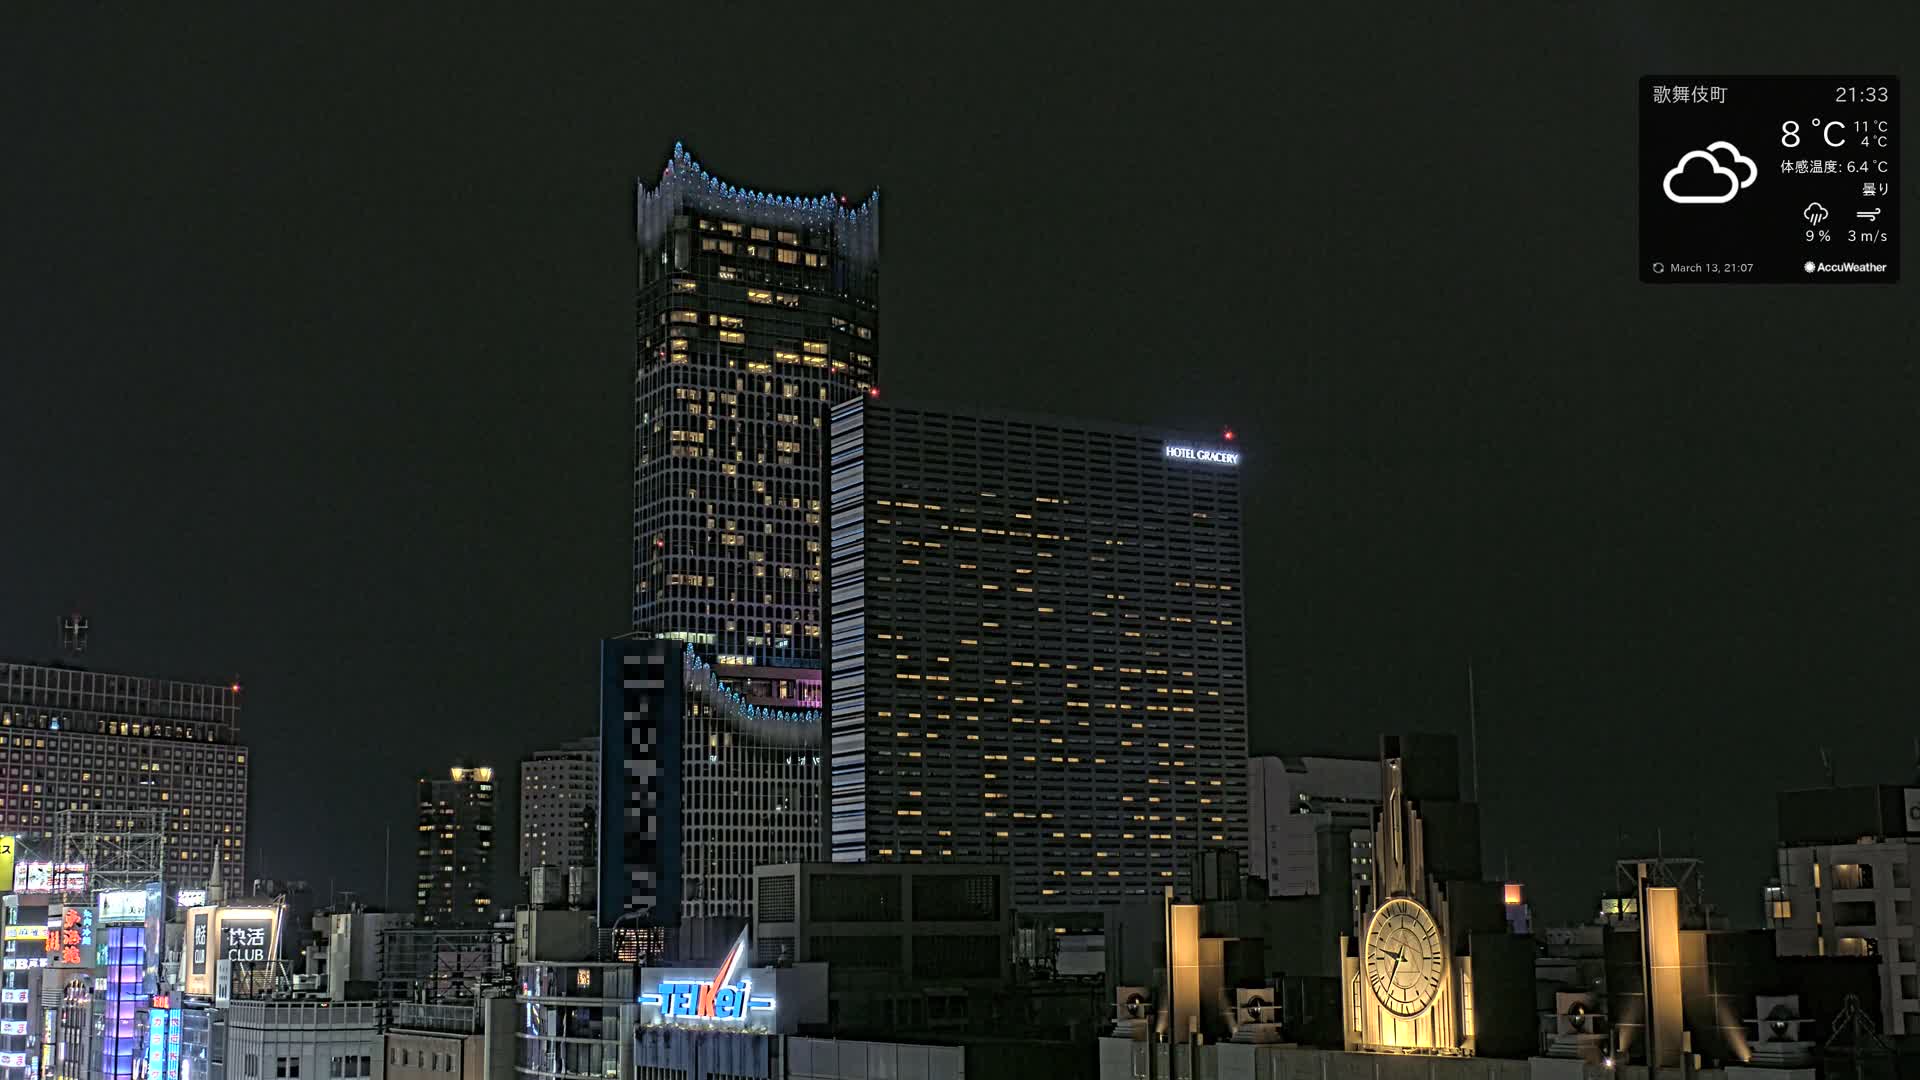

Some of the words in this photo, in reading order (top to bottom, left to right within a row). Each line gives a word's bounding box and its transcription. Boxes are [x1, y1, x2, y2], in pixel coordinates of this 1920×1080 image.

[1166, 446, 1196, 459] HOTEL
[1196, 450, 1239, 464] GRACERY
[228, 927, 265, 946] 快活
[228, 948, 264, 961] CLUB
